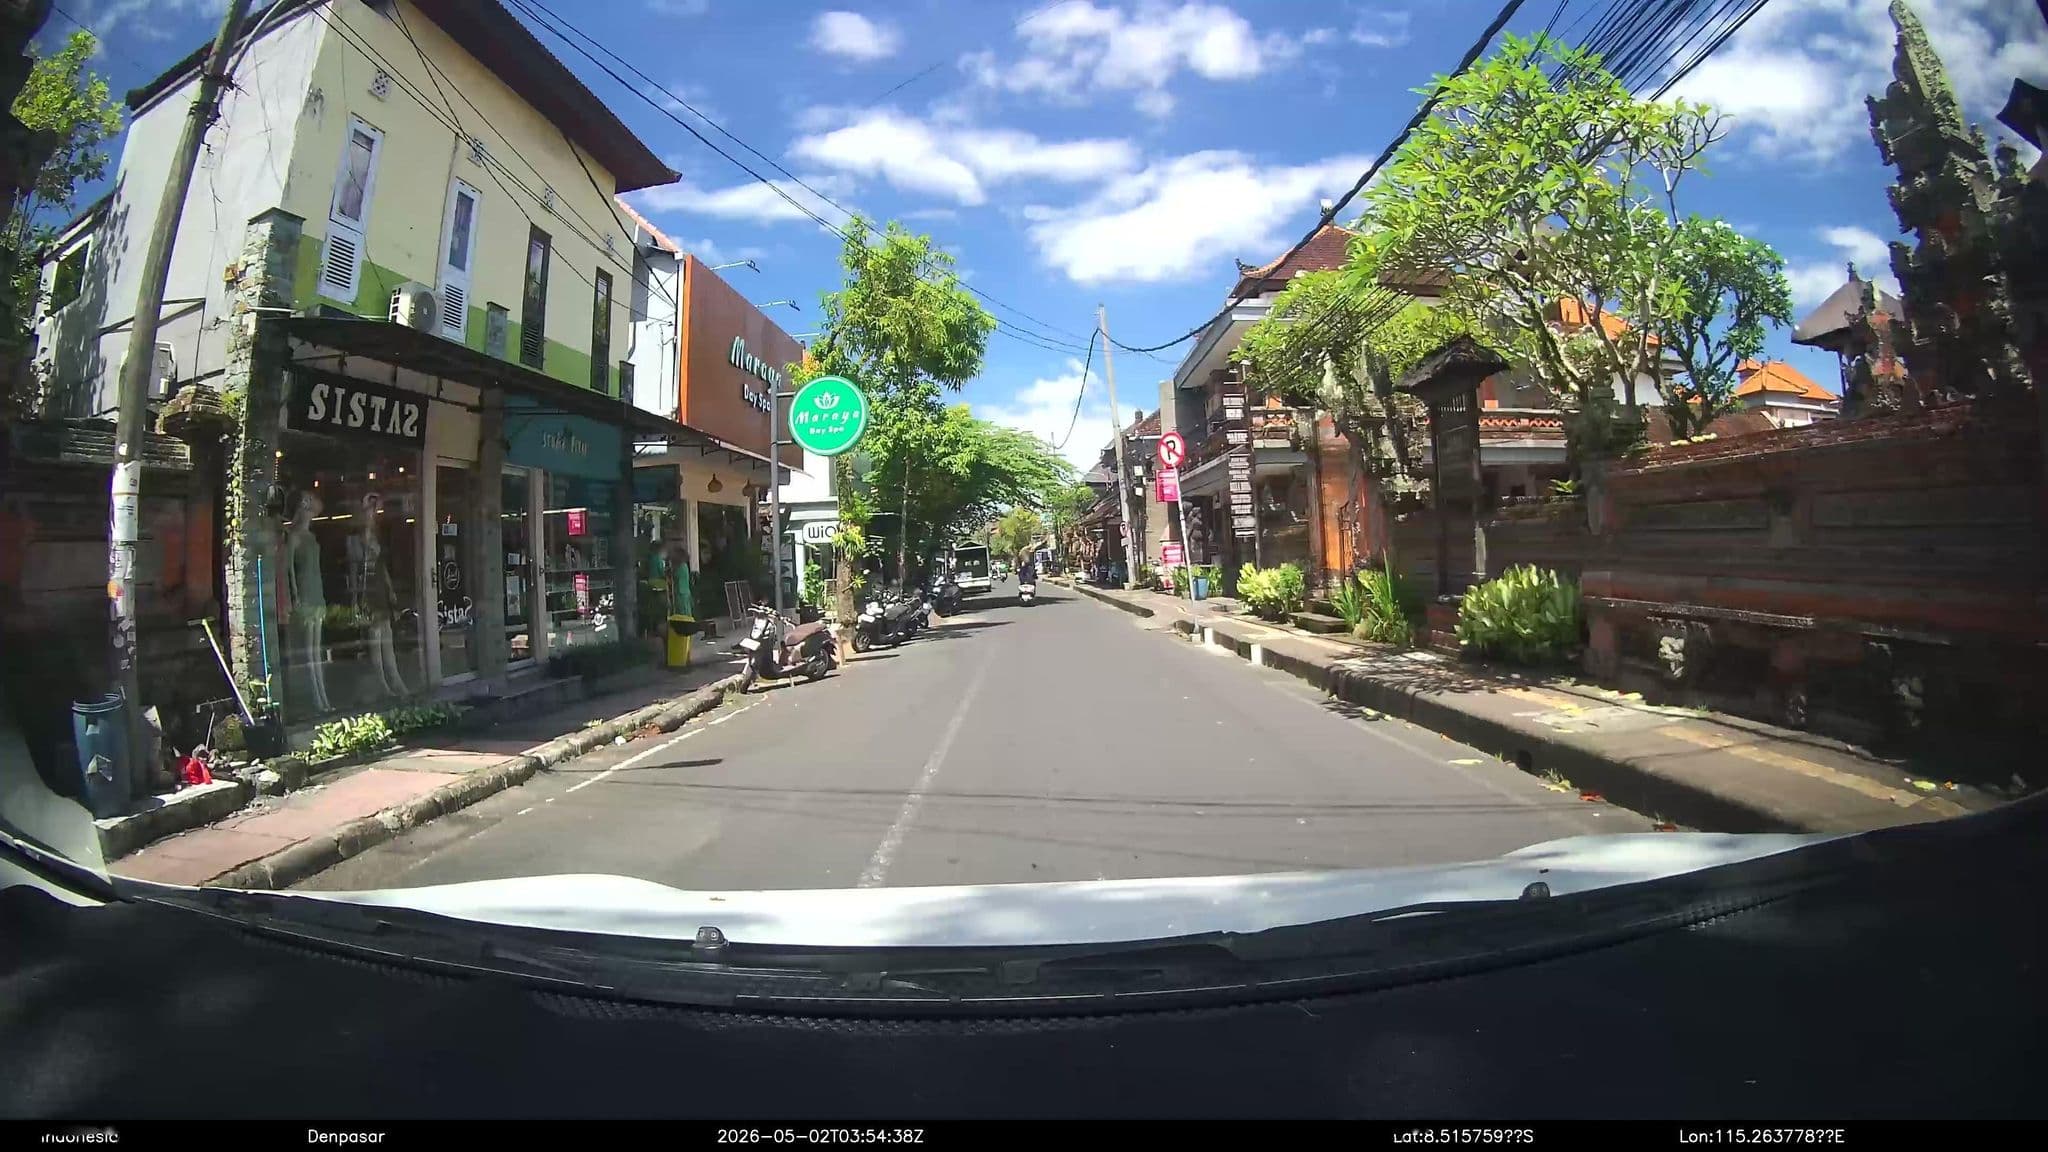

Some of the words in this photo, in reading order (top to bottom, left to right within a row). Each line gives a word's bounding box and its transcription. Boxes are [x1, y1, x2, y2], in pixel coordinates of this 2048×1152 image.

[307, 383, 419, 437] SISTAS
[744, 384, 757, 408] Day
[758, 393, 771, 413] Spa
[795, 410, 859, 424] Maraya
